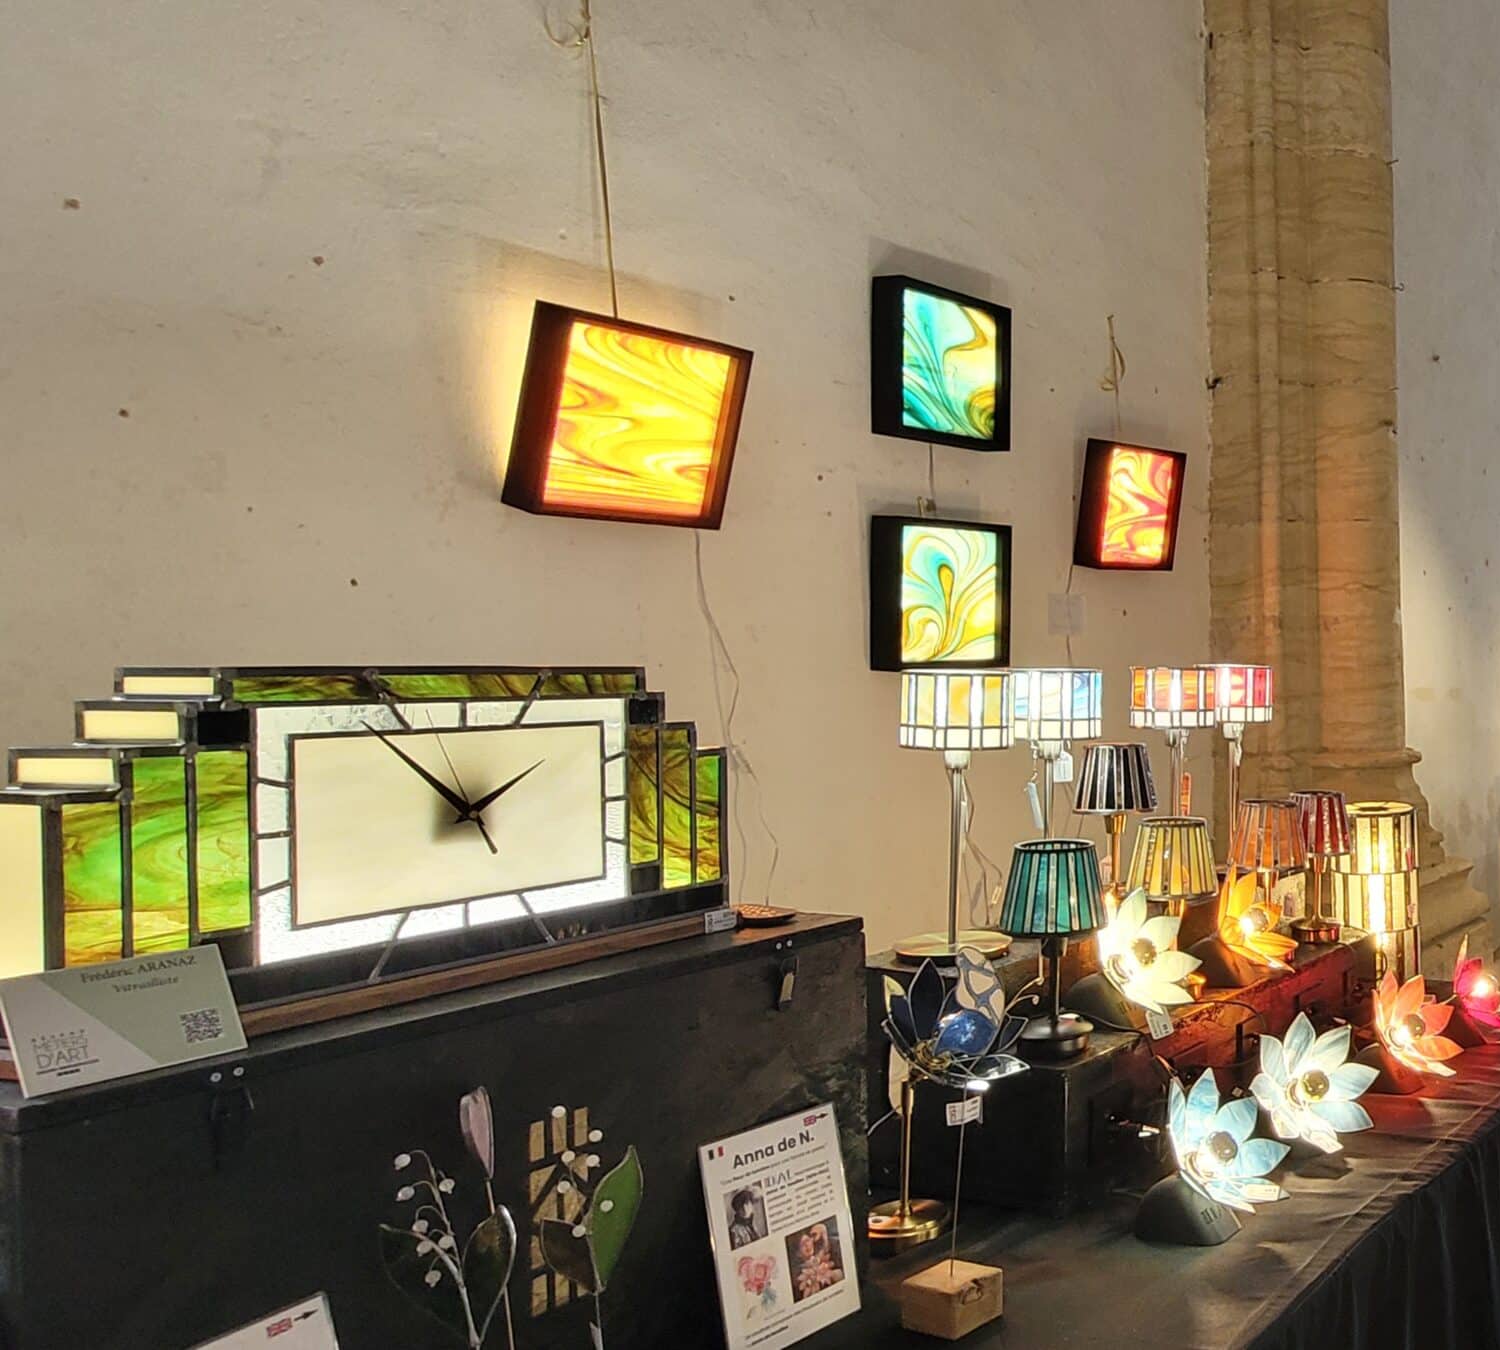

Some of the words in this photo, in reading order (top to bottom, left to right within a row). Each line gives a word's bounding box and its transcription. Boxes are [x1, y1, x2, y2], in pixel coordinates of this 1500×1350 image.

[137, 955, 197, 976] ARANAZ
[733, 1146, 775, 1168] Anna
[779, 1136, 797, 1153] de
[799, 1129, 815, 1146] N.
